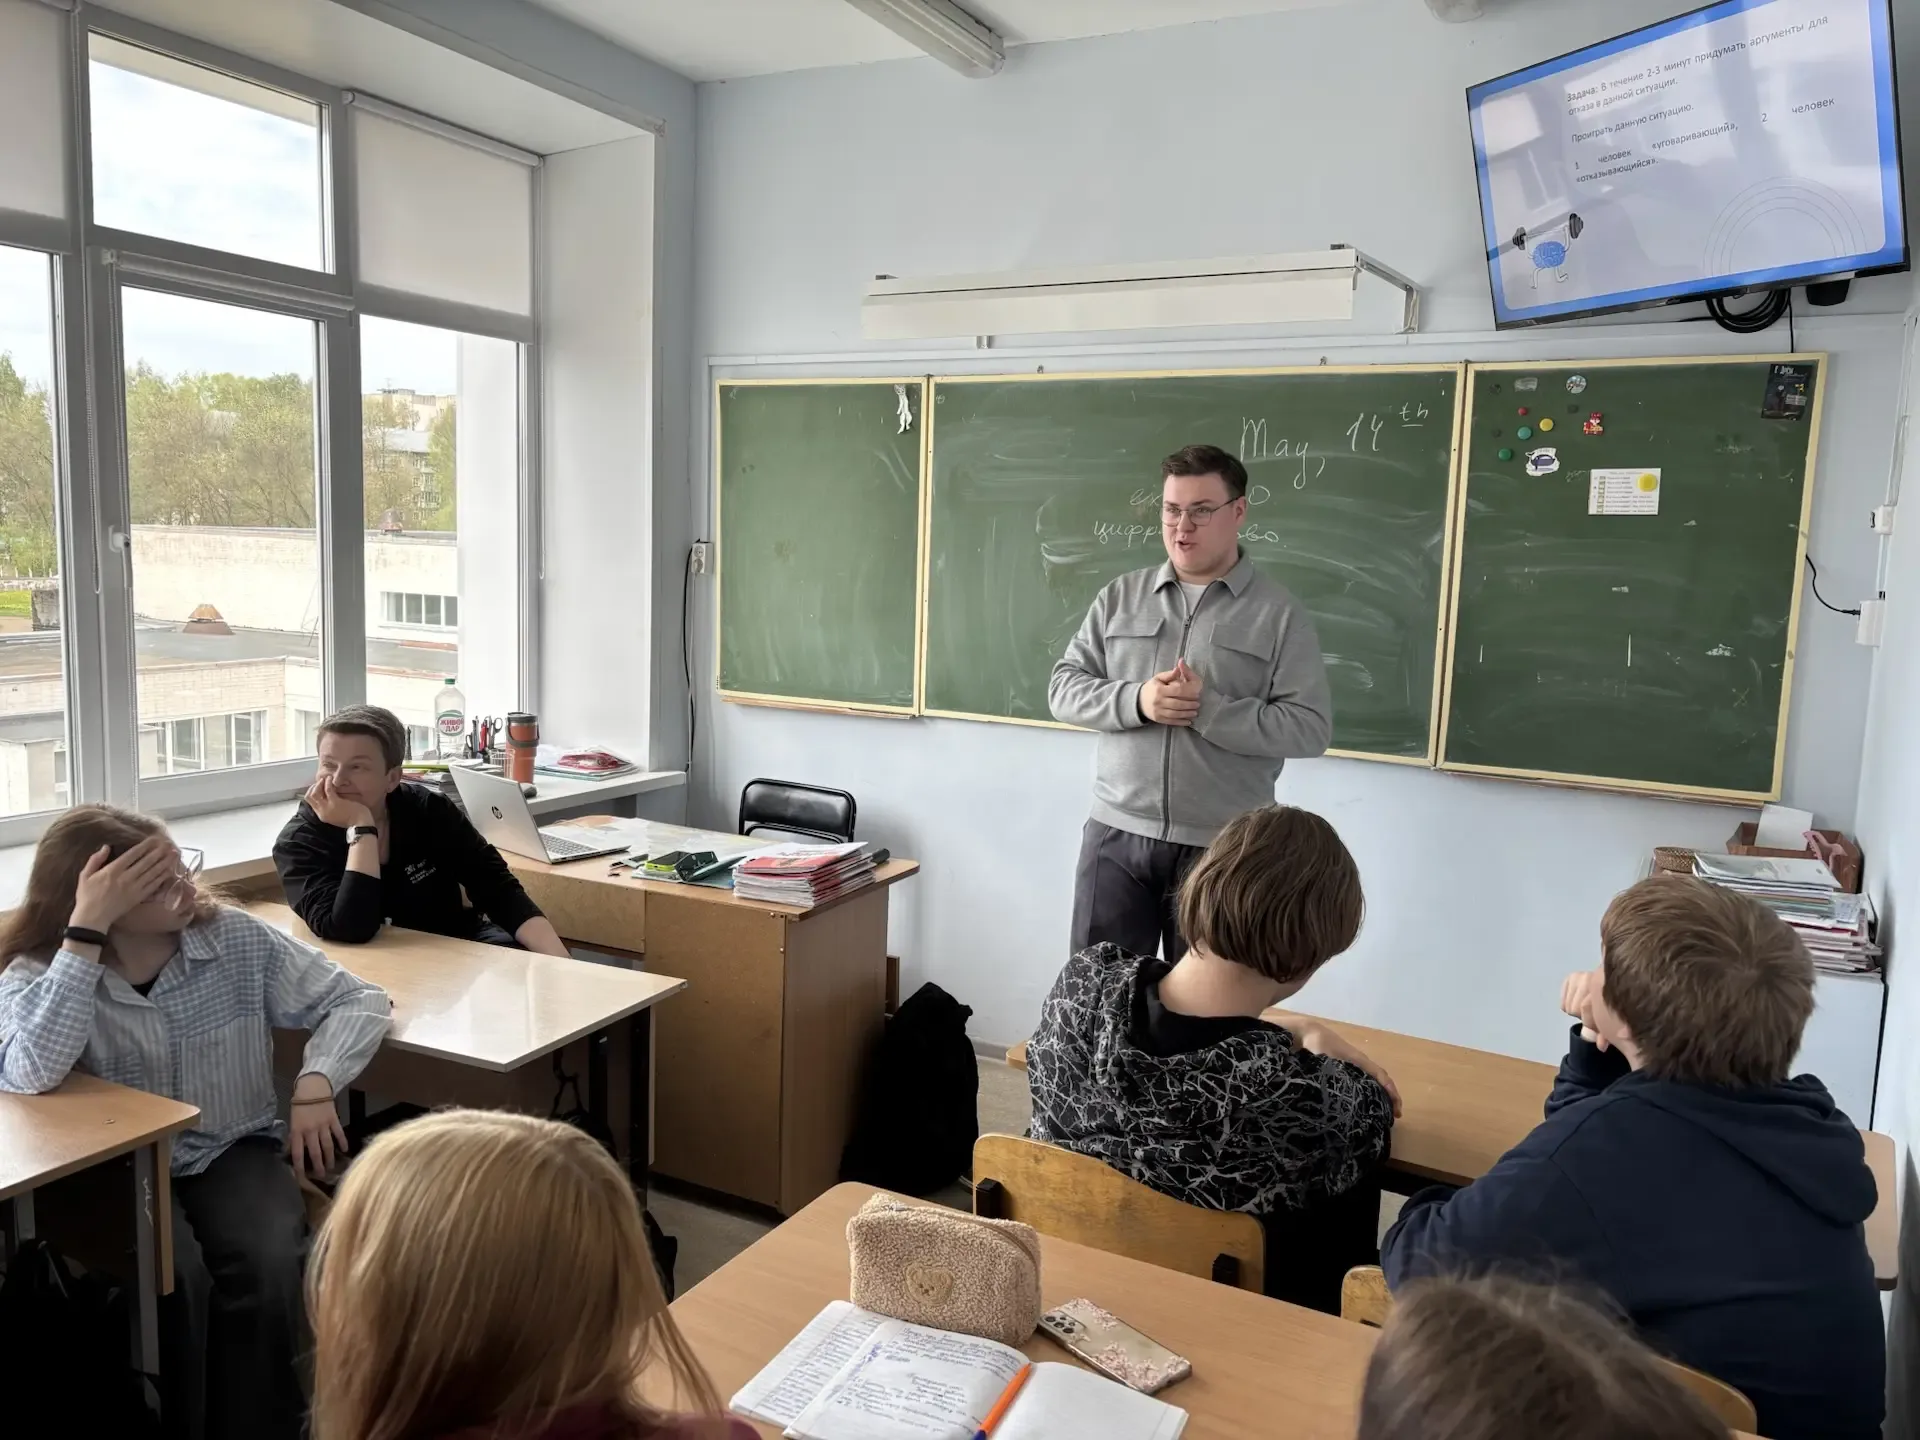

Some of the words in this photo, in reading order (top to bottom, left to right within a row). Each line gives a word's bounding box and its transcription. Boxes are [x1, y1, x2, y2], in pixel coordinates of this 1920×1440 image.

[1567, 86, 1598, 102] Задача:
[1609, 72, 1644, 88] течение
[1647, 66, 1661, 78] 2-3
[1664, 58, 1691, 72] минут
[1695, 42, 1746, 63] придумать
[1750, 23, 1804, 46] аргументы
[1808, 16, 1828, 30] для
[1568, 102, 1594, 116] отказа
[1602, 90, 1633, 107] данной
[1635, 78, 1678, 96] ситуации.
[1571, 126, 1613, 143] Проиграть
[1615, 116, 1647, 132] данную
[1649, 104, 1694, 121] ситуацию.
[1575, 161, 1580, 170] 1
[1597, 149, 1632, 163] человек
[1761, 113, 1768, 122] 2
[1791, 97, 1835, 115] человек
